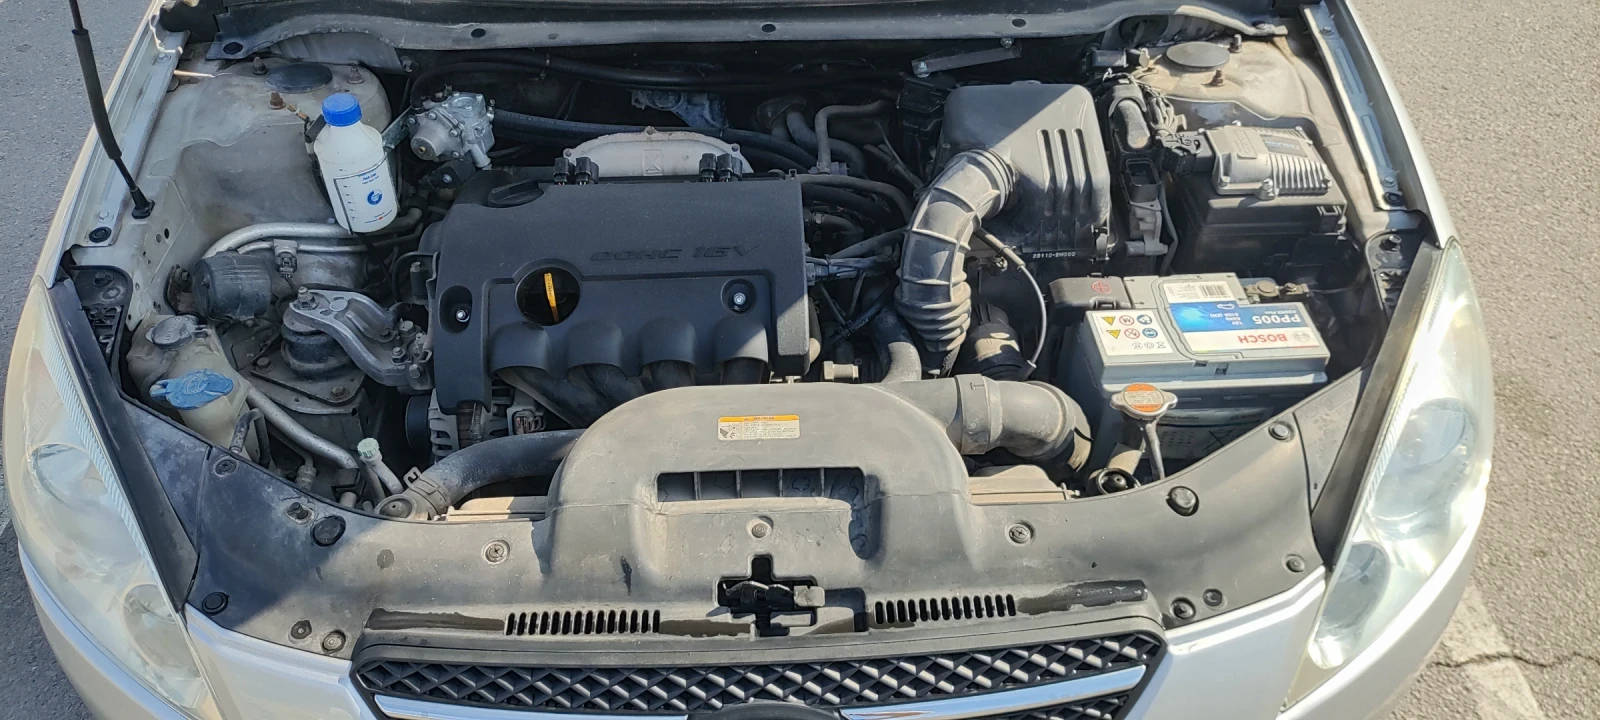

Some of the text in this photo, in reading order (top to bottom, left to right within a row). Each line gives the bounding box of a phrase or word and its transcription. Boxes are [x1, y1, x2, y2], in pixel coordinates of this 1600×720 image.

[693, 245, 761, 259] 16V
[1251, 314, 1302, 325] PP005
[1237, 333, 1288, 343] BOSCH
